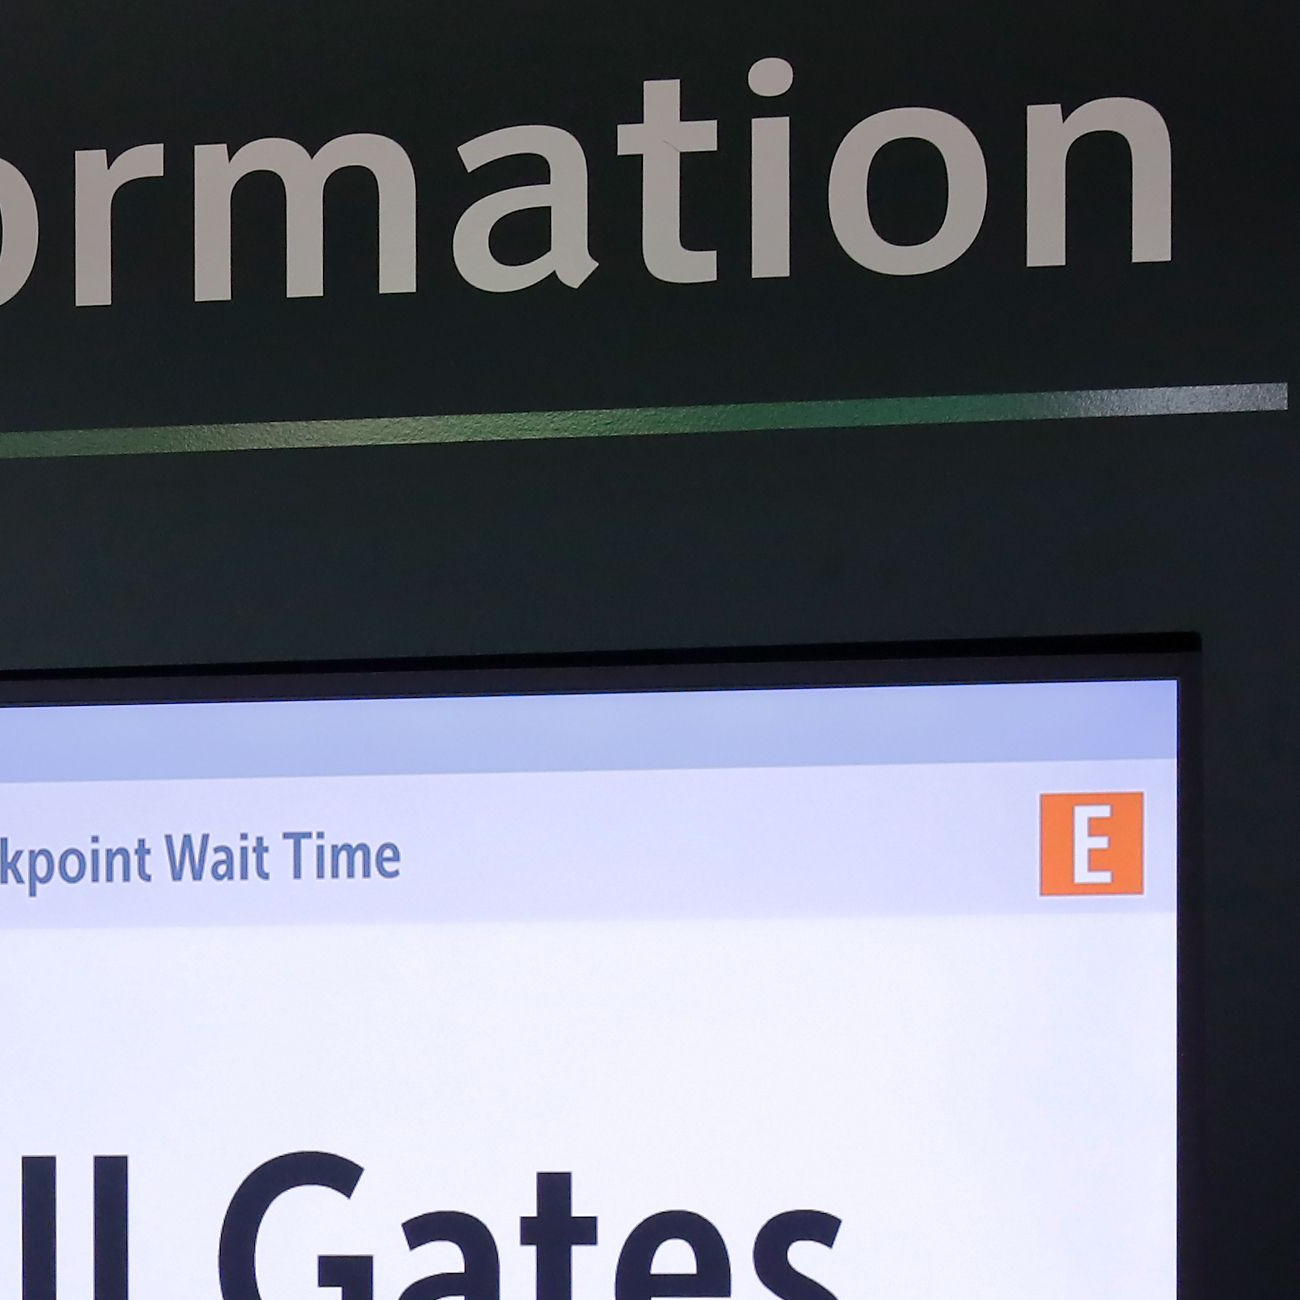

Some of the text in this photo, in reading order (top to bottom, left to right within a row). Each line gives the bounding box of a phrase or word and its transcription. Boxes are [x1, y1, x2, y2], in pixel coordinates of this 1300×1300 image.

[164, 831, 271, 883] Wait
[281, 829, 402, 881] Time
[1073, 804, 1113, 885] E
